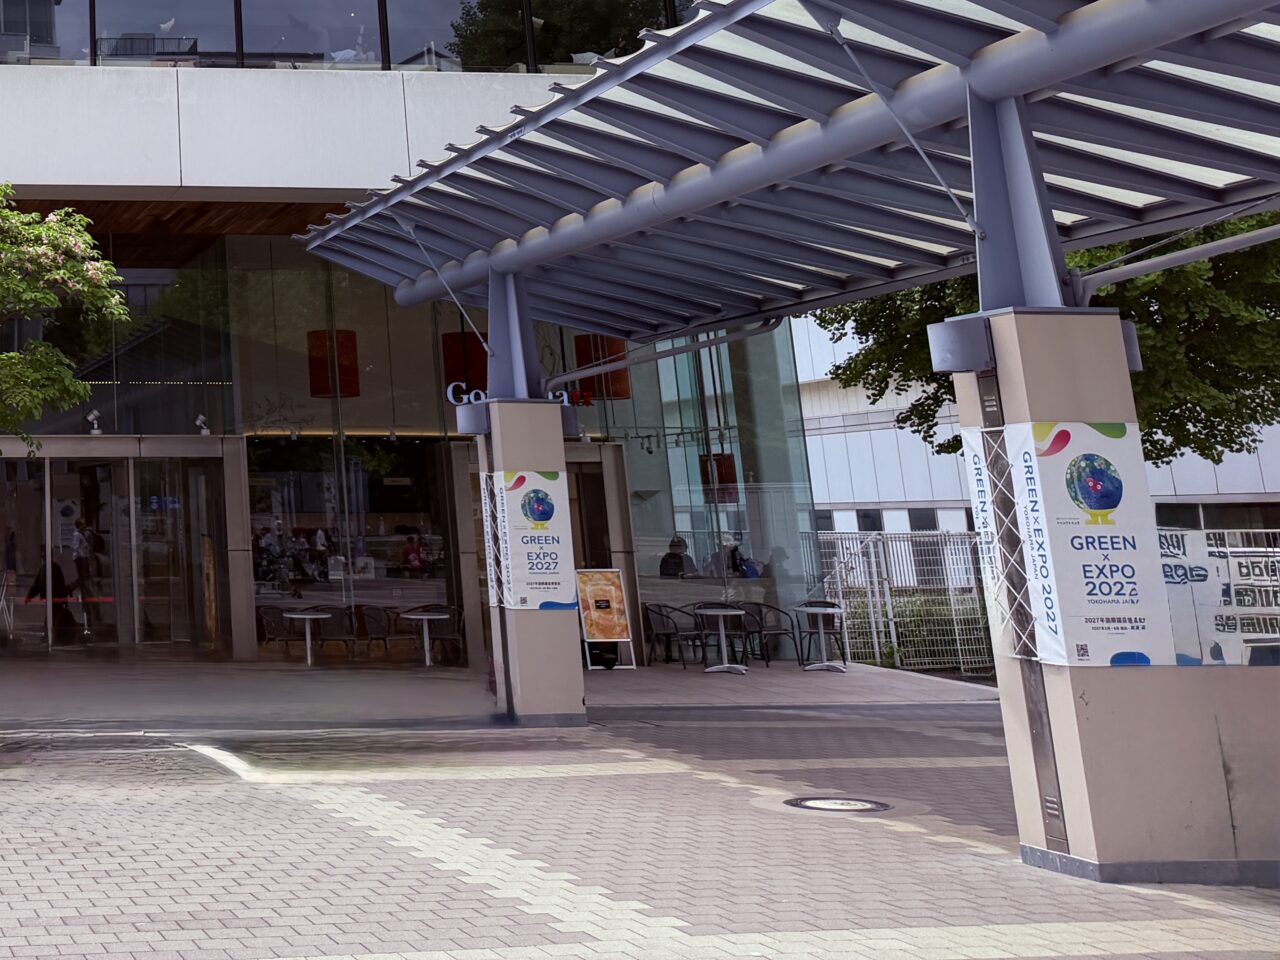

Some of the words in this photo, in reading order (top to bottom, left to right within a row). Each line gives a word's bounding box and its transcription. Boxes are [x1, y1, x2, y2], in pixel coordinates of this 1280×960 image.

[972, 454, 988, 513] GREEN
[1022, 451, 1040, 513] GREEN
[521, 535, 560, 545] GREEN
[527, 551, 558, 561] EXPO
[1023, 505, 1035, 553] YOKOHAMA
[1030, 553, 1039, 580] JAPAN
[1033, 528, 1050, 580] EXPO
[1070, 535, 1137, 551] GREEN
[528, 561, 559, 571] 2027
[1082, 564, 1136, 579] EXPO
[1041, 583, 1059, 636] 2027
